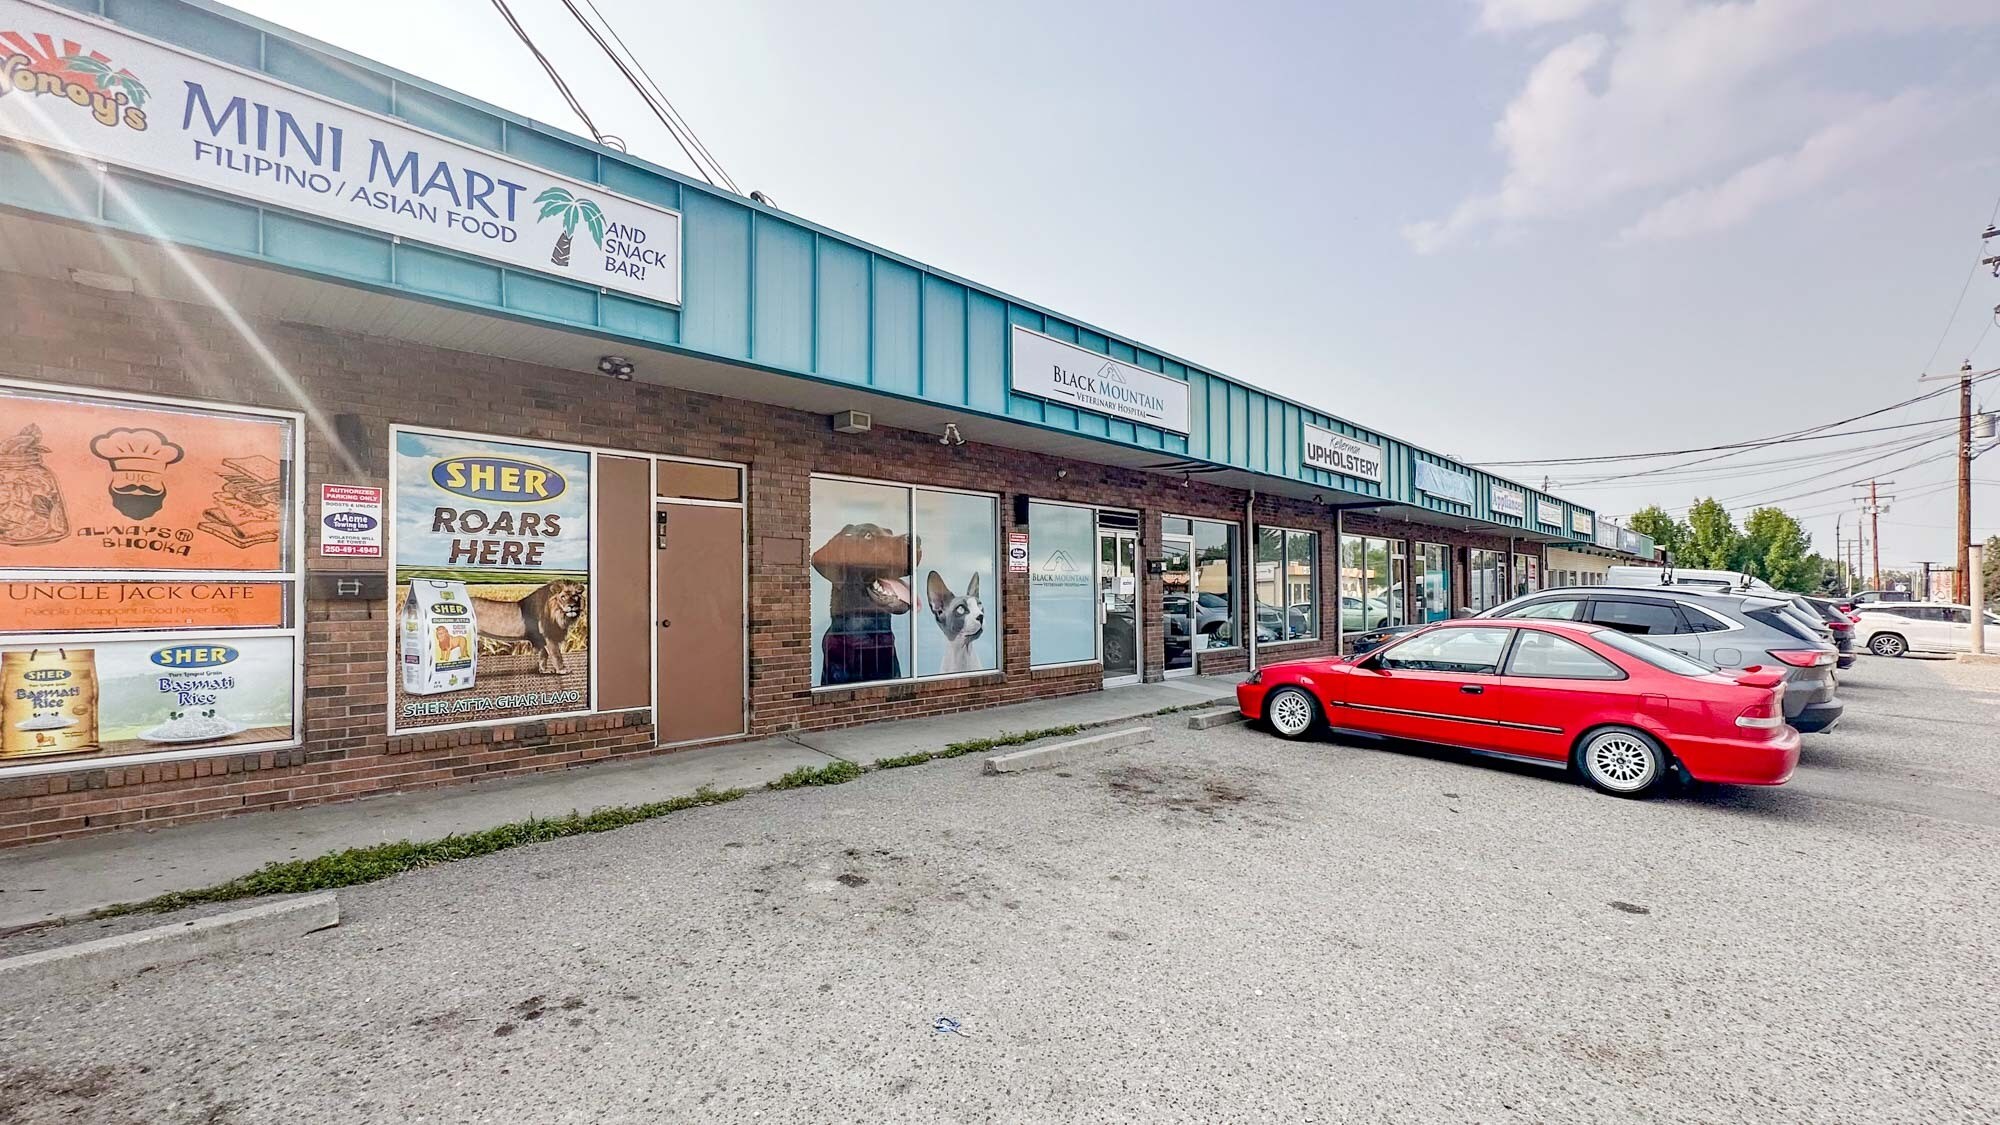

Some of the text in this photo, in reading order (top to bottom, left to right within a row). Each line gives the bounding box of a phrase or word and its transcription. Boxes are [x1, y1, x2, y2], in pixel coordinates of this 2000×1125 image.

[183, 80, 527, 222] MINI MART
[351, 187, 437, 223] ASIAN
[447, 210, 517, 243] FOOD
[605, 221, 646, 244] AND
[605, 239, 667, 269] SNACK
[605, 258, 646, 281] BAR!
[1053, 365, 1164, 412] BLACK MOUNTAIN
[1076, 391, 1146, 418] VETERINARY HOSPITAL
[1307, 442, 1379, 477] UPHOLSTERY
[446, 461, 549, 498] SHER
[334, 513, 368, 523] AAcme
[432, 507, 562, 537] ROARS
[77, 525, 171, 538] ALWAYS
[103, 537, 191, 557] BHOOKA
[324, 545, 378, 554] 250-491-4949
[448, 539, 545, 565] HERE
[1032, 573, 1089, 582] BLACK MOUNTAIN
[8, 583, 254, 603] UNCLE JACK CAFE
[434, 604, 464, 614] SHER
[160, 647, 227, 664] SHER
[28, 670, 65, 680] SHER
[159, 676, 235, 693] Basmati
[178, 691, 216, 706] Rice
[404, 690, 580, 717] SHER ATTA GHAR LAAO
